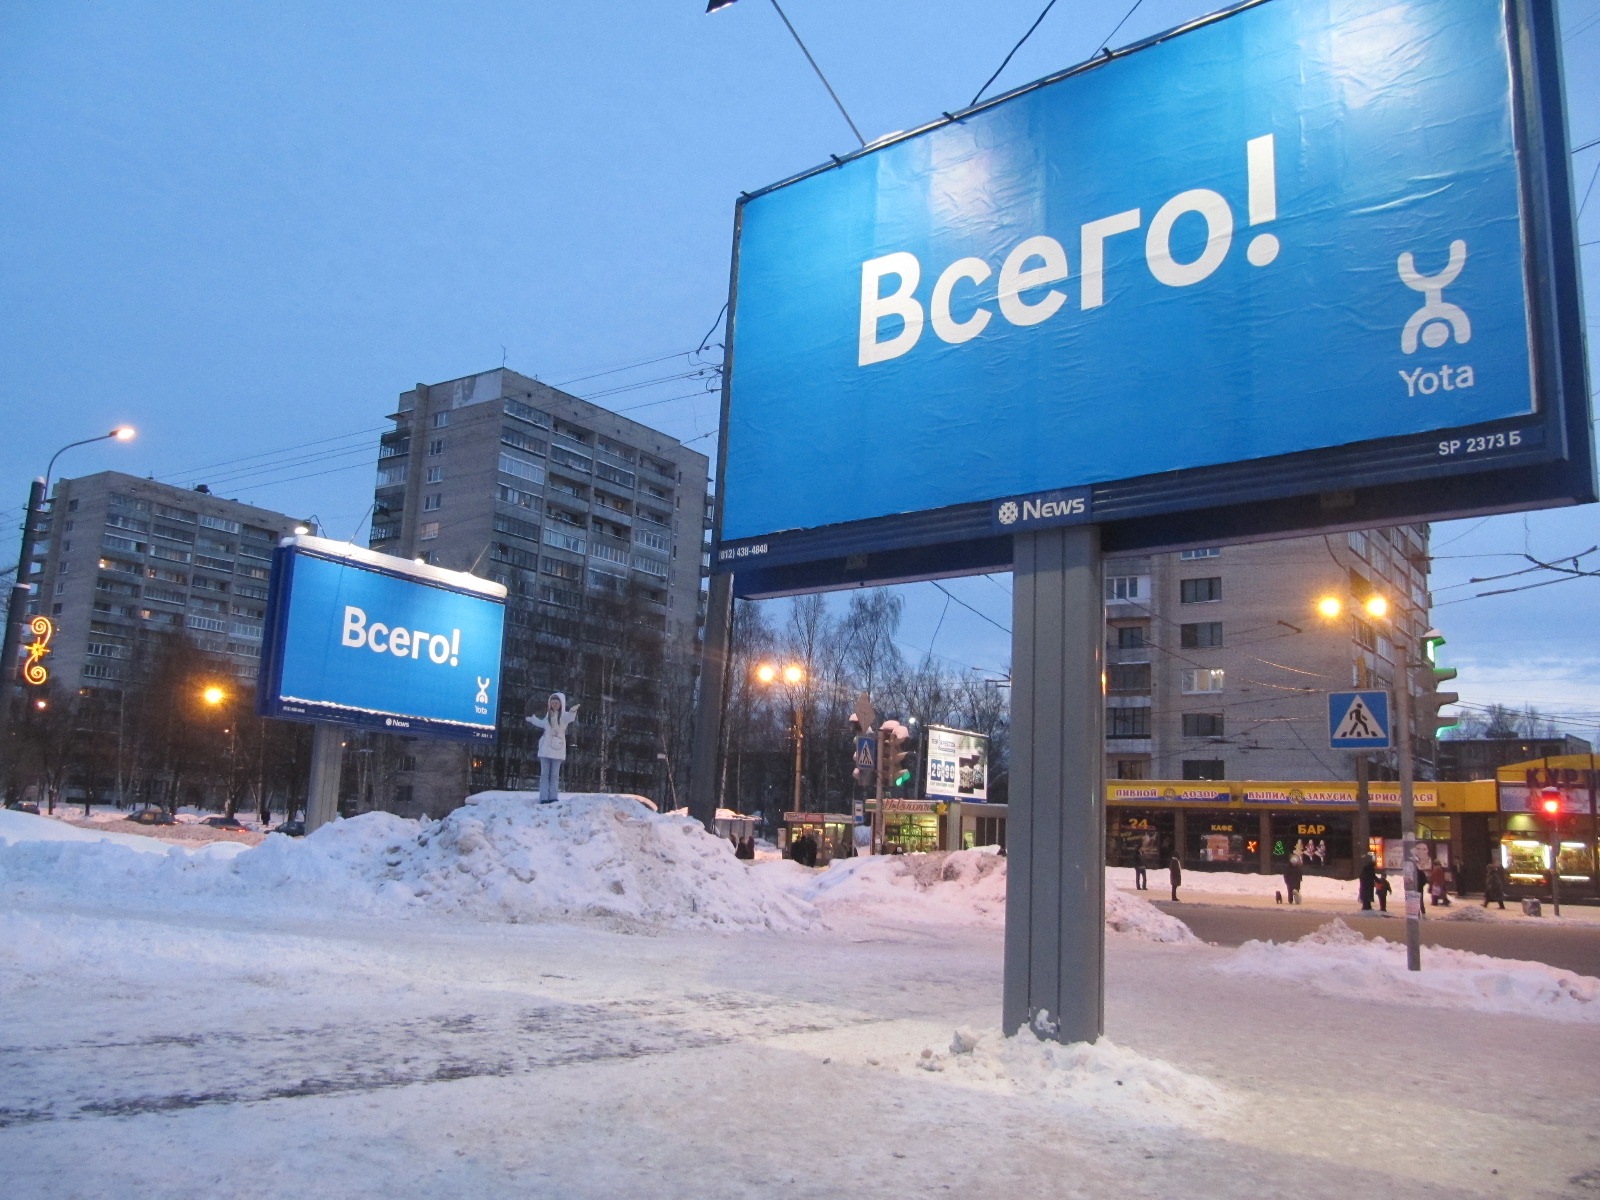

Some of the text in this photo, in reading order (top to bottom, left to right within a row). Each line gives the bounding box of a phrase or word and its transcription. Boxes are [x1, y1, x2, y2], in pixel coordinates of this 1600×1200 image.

[858, 133, 1280, 367] Всего!
[1398, 364, 1475, 398] Yota
[1438, 439, 1461, 456] SP
[1022, 498, 1085, 520] News
[341, 605, 461, 667] Всего!
[474, 704, 488, 715] Yota
[392, 718, 410, 728] News
[1115, 788, 1219, 799] ПИВНОЙ ДОЗОР
[1248, 791, 1287, 800] ВЫПИЛ
[1306, 792, 1353, 801] ЗАКУСИЛ
[1129, 818, 1149, 830] 24
[1210, 824, 1233, 832] КАФЕ
[1297, 824, 1326, 835] БАР
